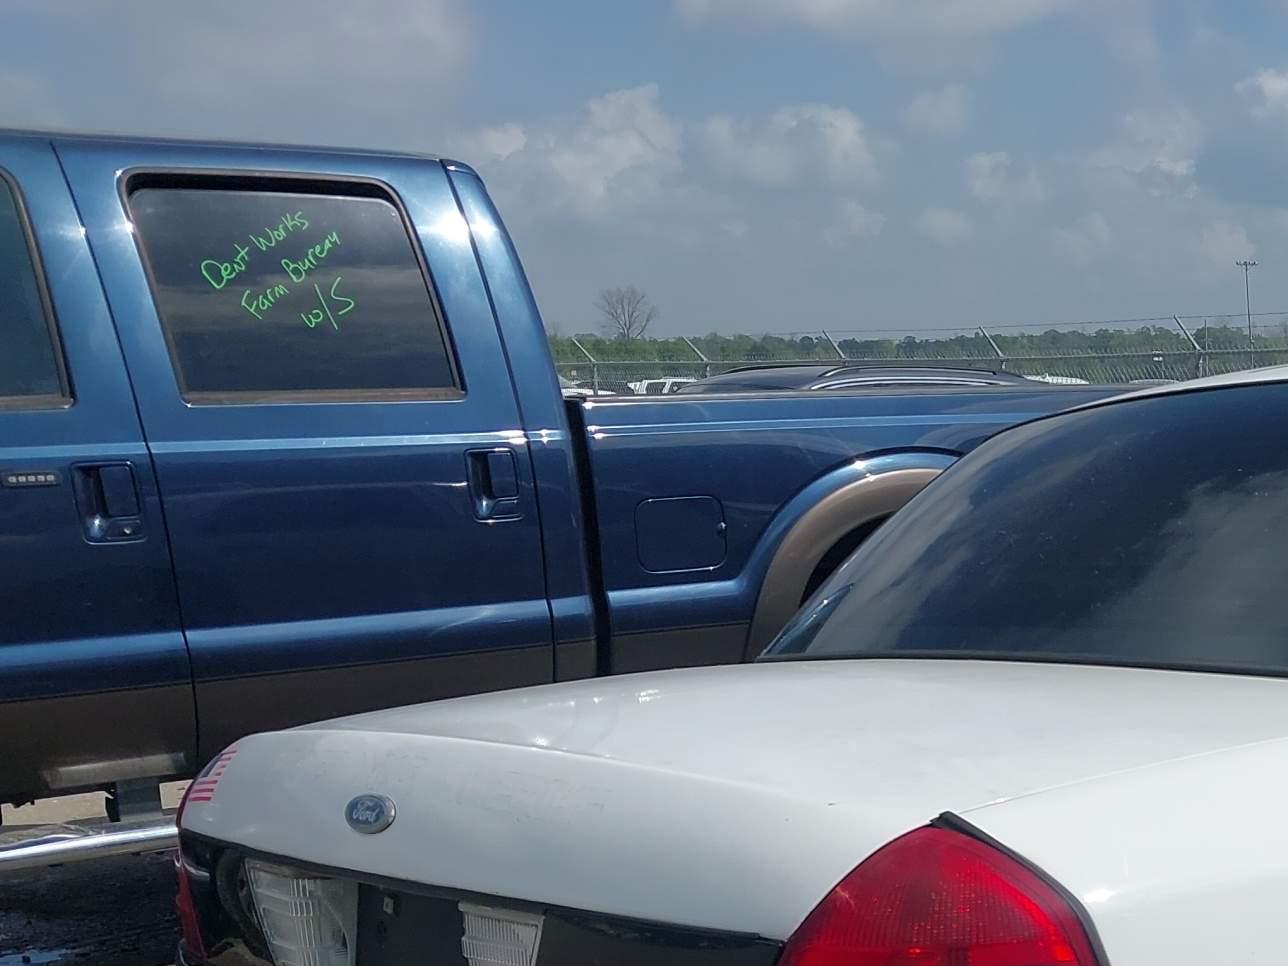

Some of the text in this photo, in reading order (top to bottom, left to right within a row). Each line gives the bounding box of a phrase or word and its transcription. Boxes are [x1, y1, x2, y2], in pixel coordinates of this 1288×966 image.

[201, 211, 309, 289] Dent Works
[241, 284, 289, 319] Farm
[352, 800, 381, 822] Ford
